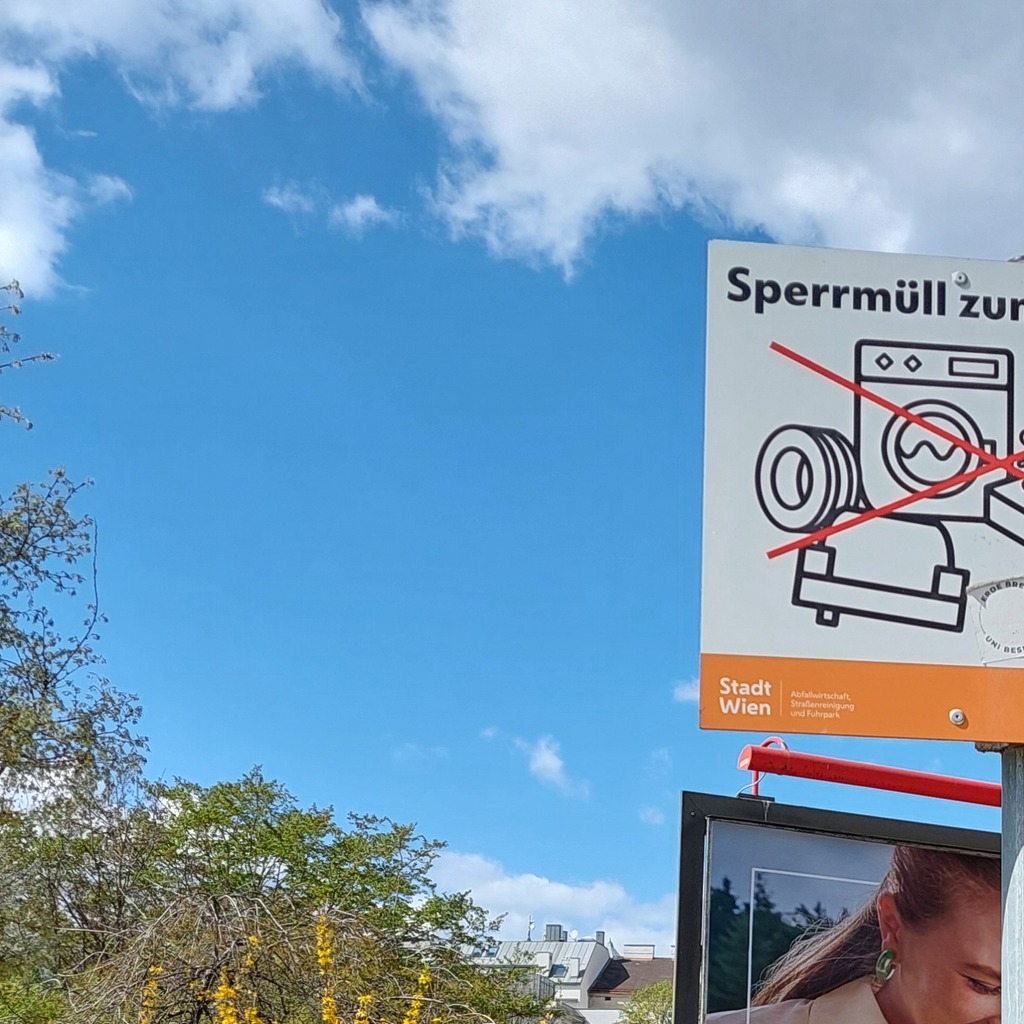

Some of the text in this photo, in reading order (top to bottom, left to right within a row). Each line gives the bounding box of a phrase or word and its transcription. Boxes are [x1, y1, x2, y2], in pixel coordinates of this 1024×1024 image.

[727, 266, 946, 316] Sperrmüll
[981, 583, 1002, 602] ERDE
[985, 635, 1001, 650] UNI
[719, 677, 772, 696] Stadt
[790, 690, 851, 701] Abfallwirtschaft,
[719, 697, 771, 716] Wien
[790, 700, 855, 712] Straßenreinigung
[806, 710, 840, 719] Fuhrpark
